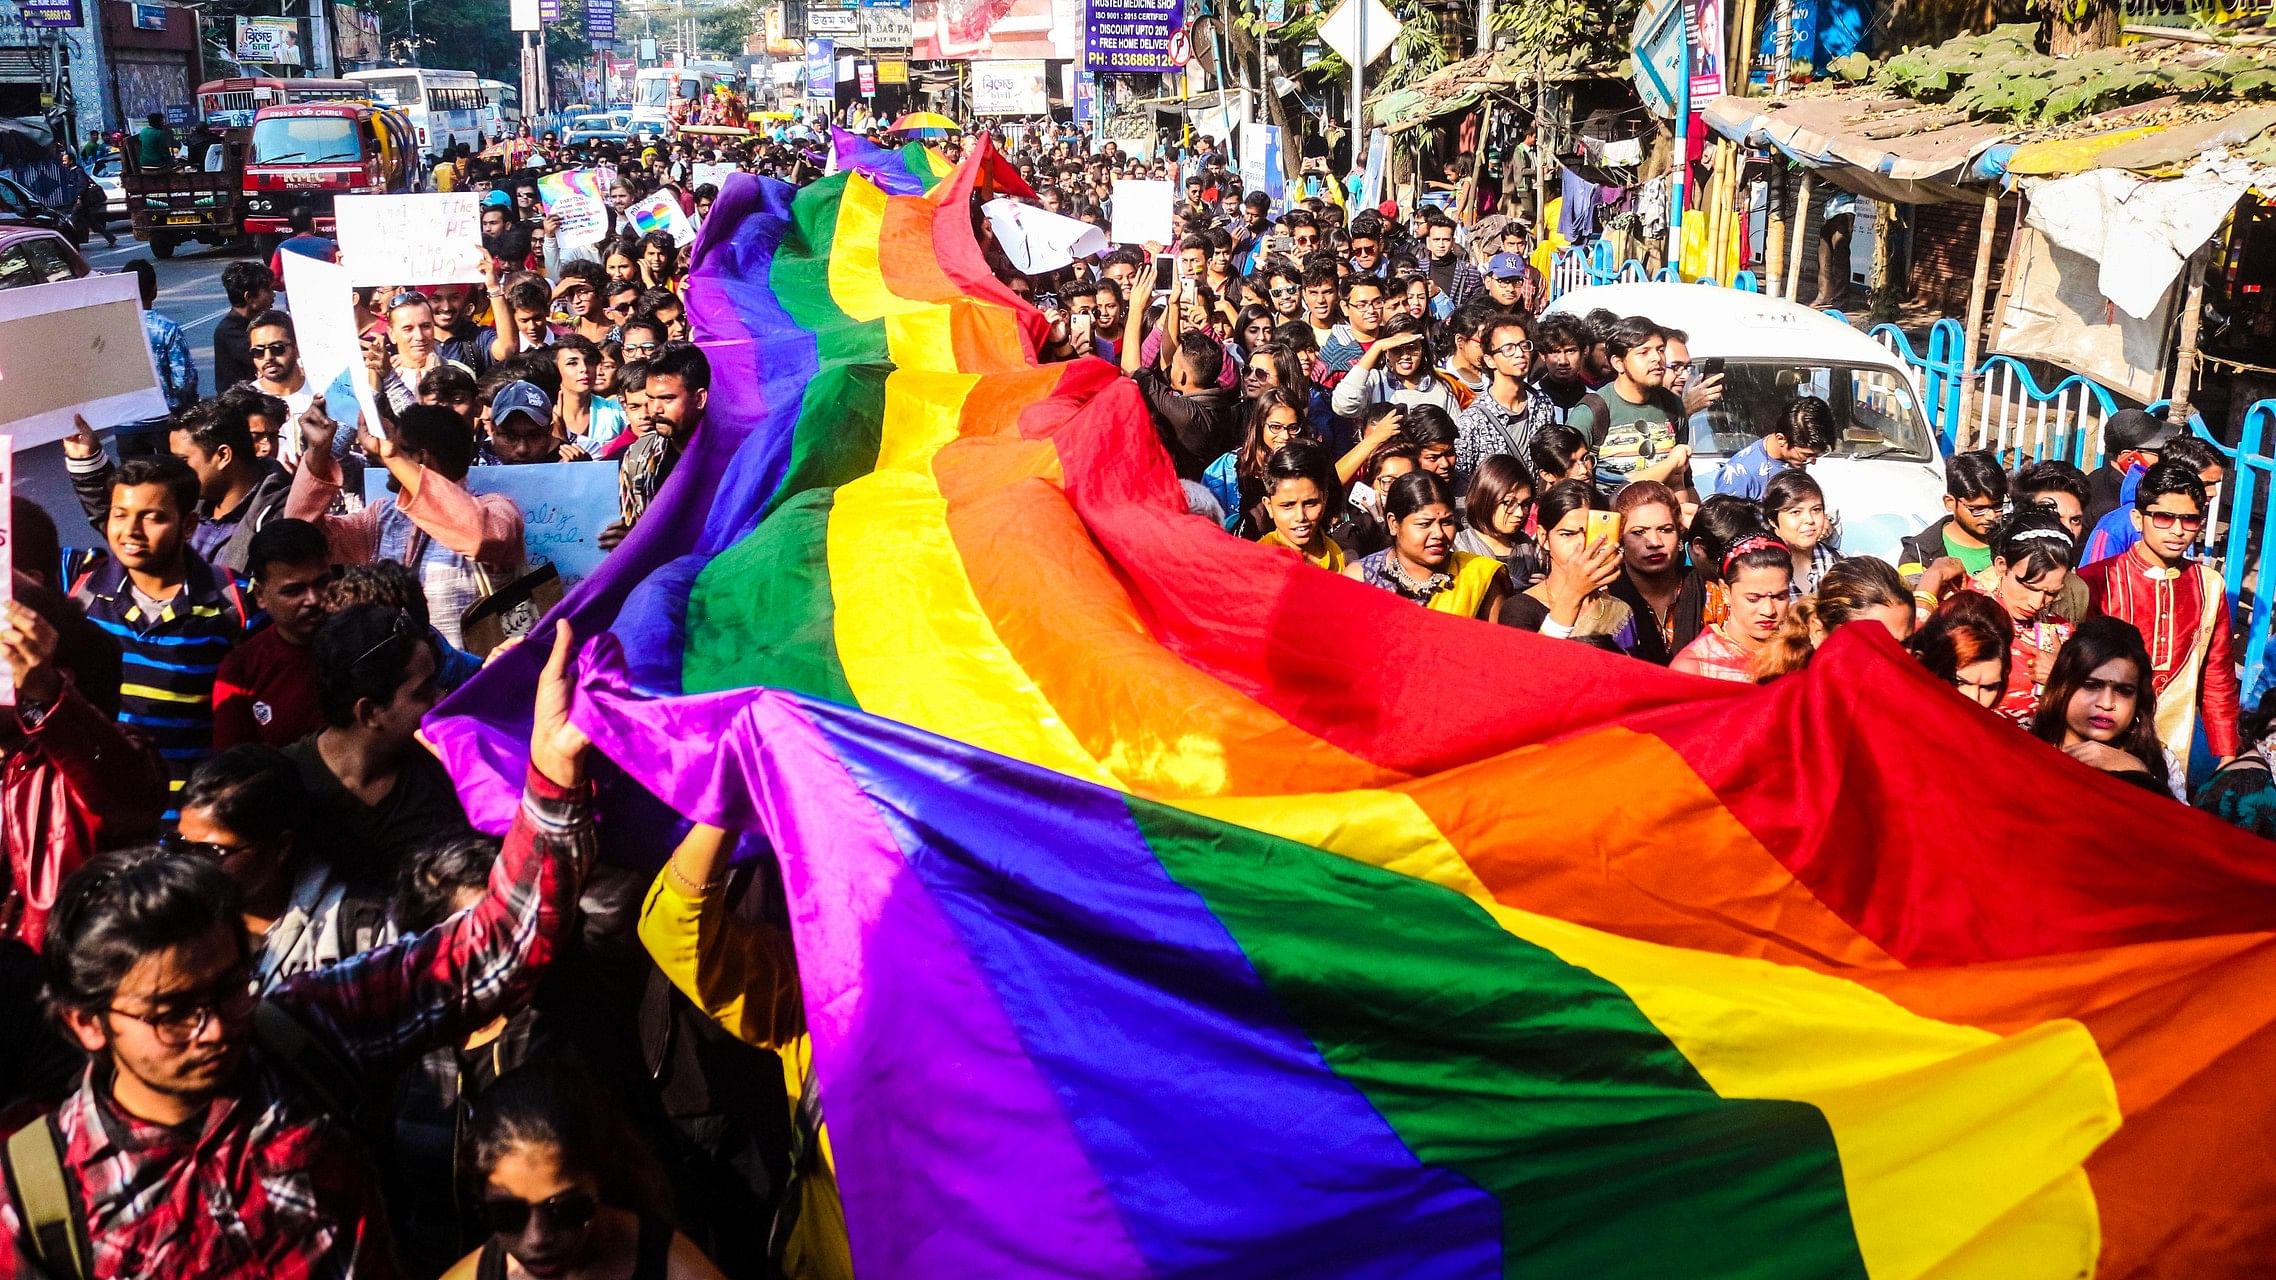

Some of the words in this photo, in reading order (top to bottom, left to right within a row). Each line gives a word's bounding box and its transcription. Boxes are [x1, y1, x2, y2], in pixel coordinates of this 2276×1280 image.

[1091, 0, 1121, 8] TRUSTED
[1123, 0, 1156, 9] MEDICINE
[1157, 0, 1177, 9] SHOP
[1106, 12, 1119, 20] 9001
[1138, 13, 1168, 21] CERTIFIED
[1099, 24, 1135, 35] DISCOUNT
[1135, 25, 1154, 35] UPTO
[1154, 25, 1168, 36] 20%
[1099, 38, 1118, 49] FREE
[1118, 38, 1139, 49] HOME
[1140, 39, 1168, 50] DELIVER
[1088, 52, 1108, 65] PH:
